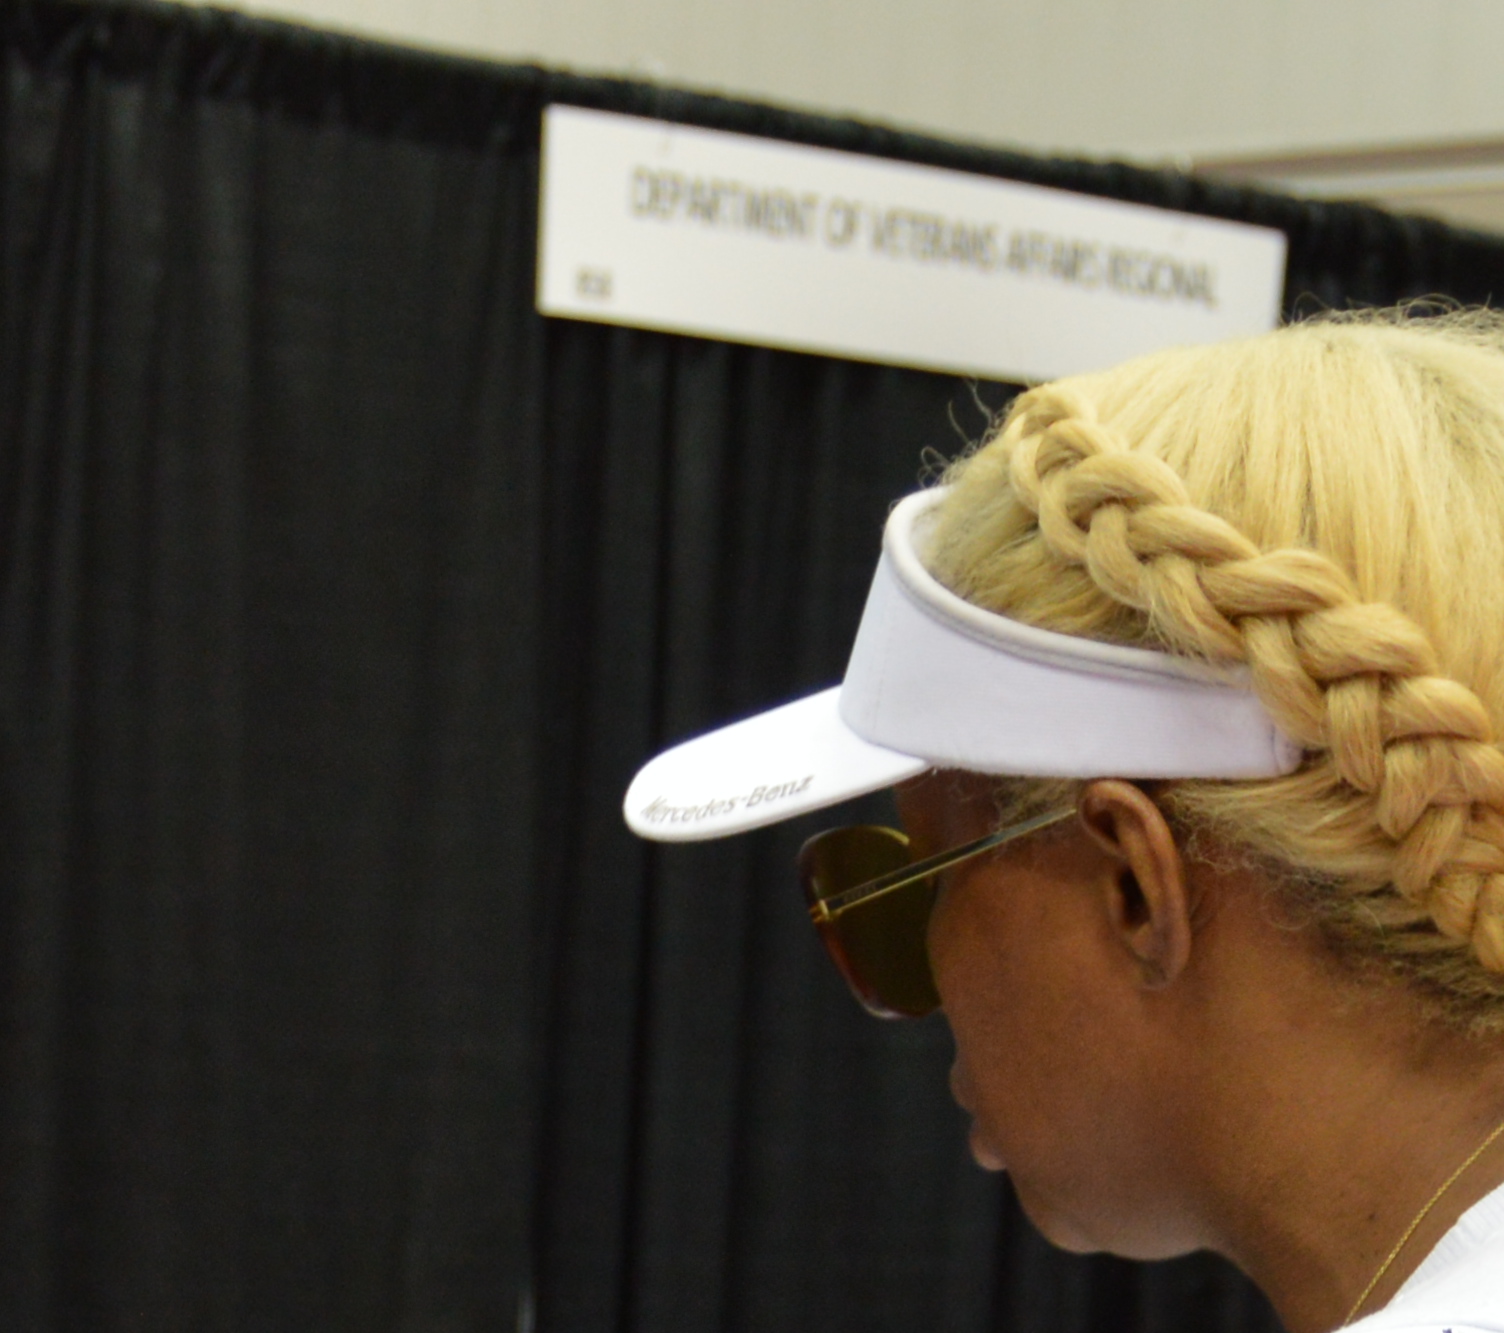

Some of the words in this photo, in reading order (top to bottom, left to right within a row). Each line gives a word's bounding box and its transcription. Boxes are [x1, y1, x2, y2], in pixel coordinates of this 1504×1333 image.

[630, 167, 820, 243] DEPARTMENT
[826, 197, 858, 245] OF
[869, 208, 1002, 272] VETERANS
[1006, 228, 1102, 282] AFFAIRS
[639, 774, 815, 823] Mercedes-Benz
